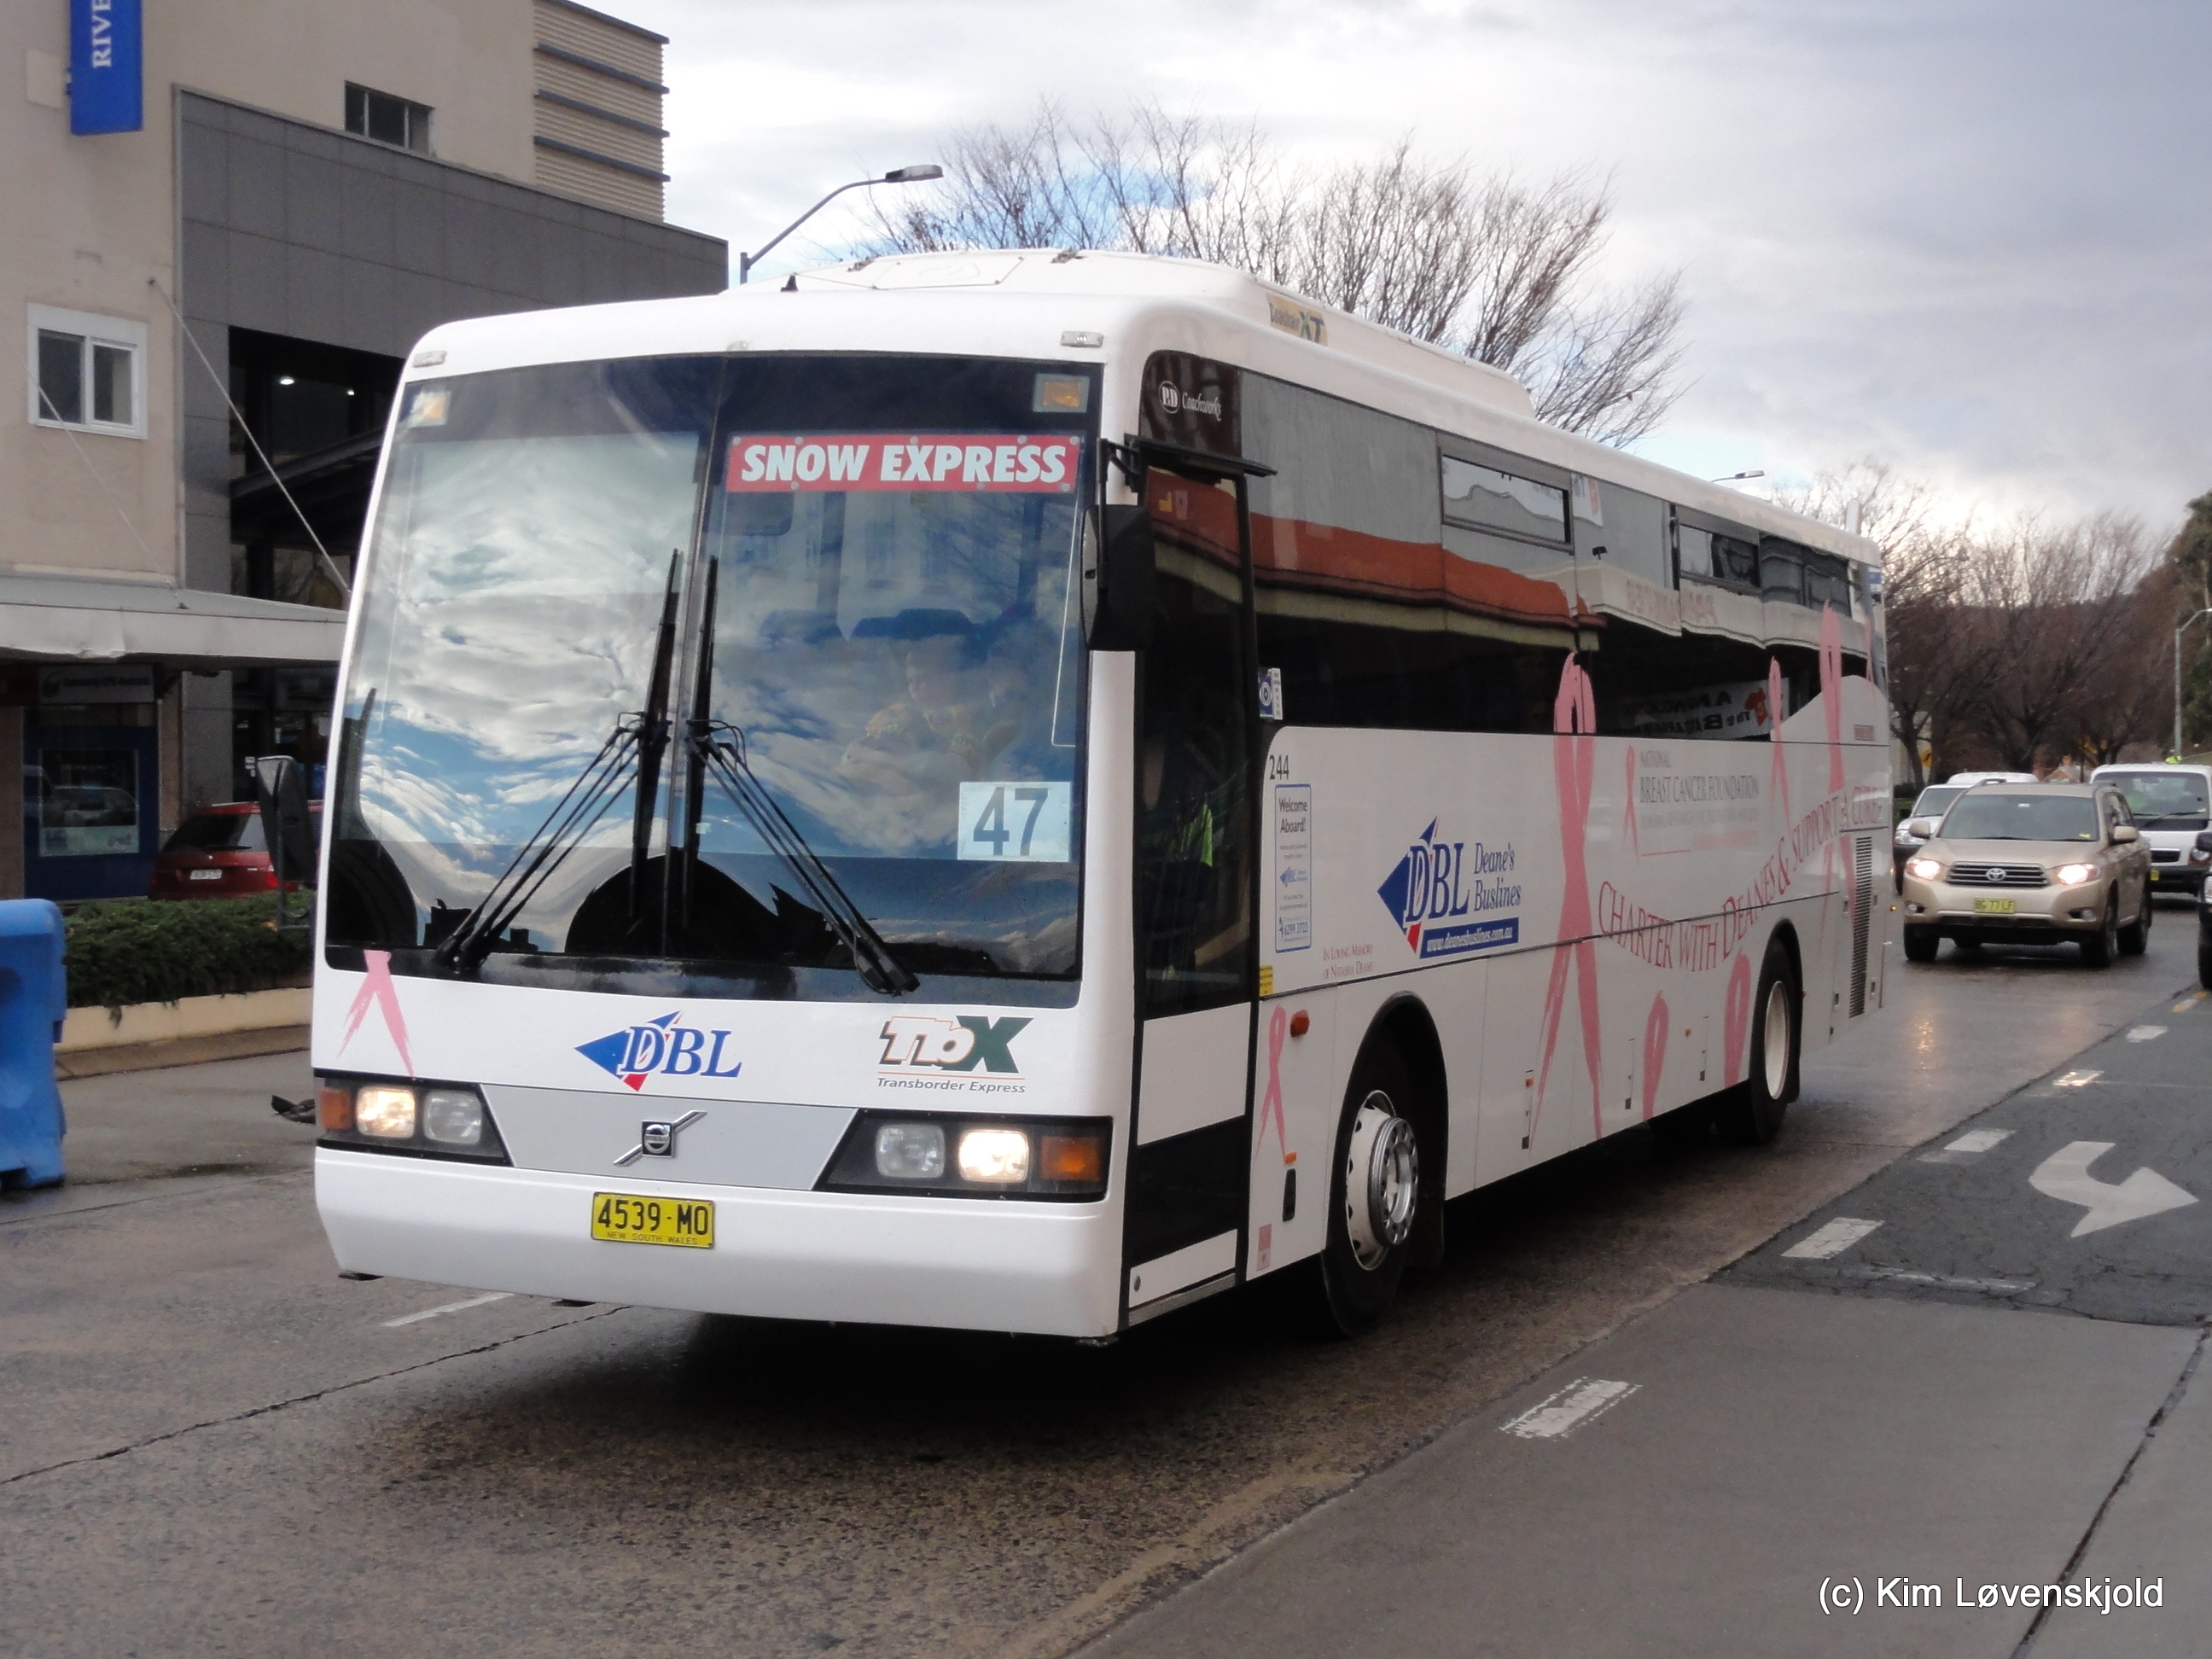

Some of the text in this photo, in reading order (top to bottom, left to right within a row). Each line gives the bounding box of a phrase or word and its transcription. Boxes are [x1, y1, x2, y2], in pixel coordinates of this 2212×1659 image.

[741, 445, 1067, 483] SNOW EXPRESS
[1269, 754, 1289, 780] 244
[1278, 797, 1308, 812] Welcome
[1640, 775, 1760, 804] BREAST CANCER FOUNDATION
[973, 786, 1049, 856] 47
[1474, 842, 1515, 875] Deane's
[1406, 842, 1470, 923] DBL
[1474, 876, 1522, 911] Buslines
[1598, 881, 1674, 969] CHARTER
[1678, 923, 1719, 972] WITH
[1792, 795, 1839, 872] SUPPORT
[620, 1026, 742, 1078] DBL
[877, 1077, 1026, 1094] Transborder Express
[607, 1231, 698, 1245] NEW SOUTH WALES
